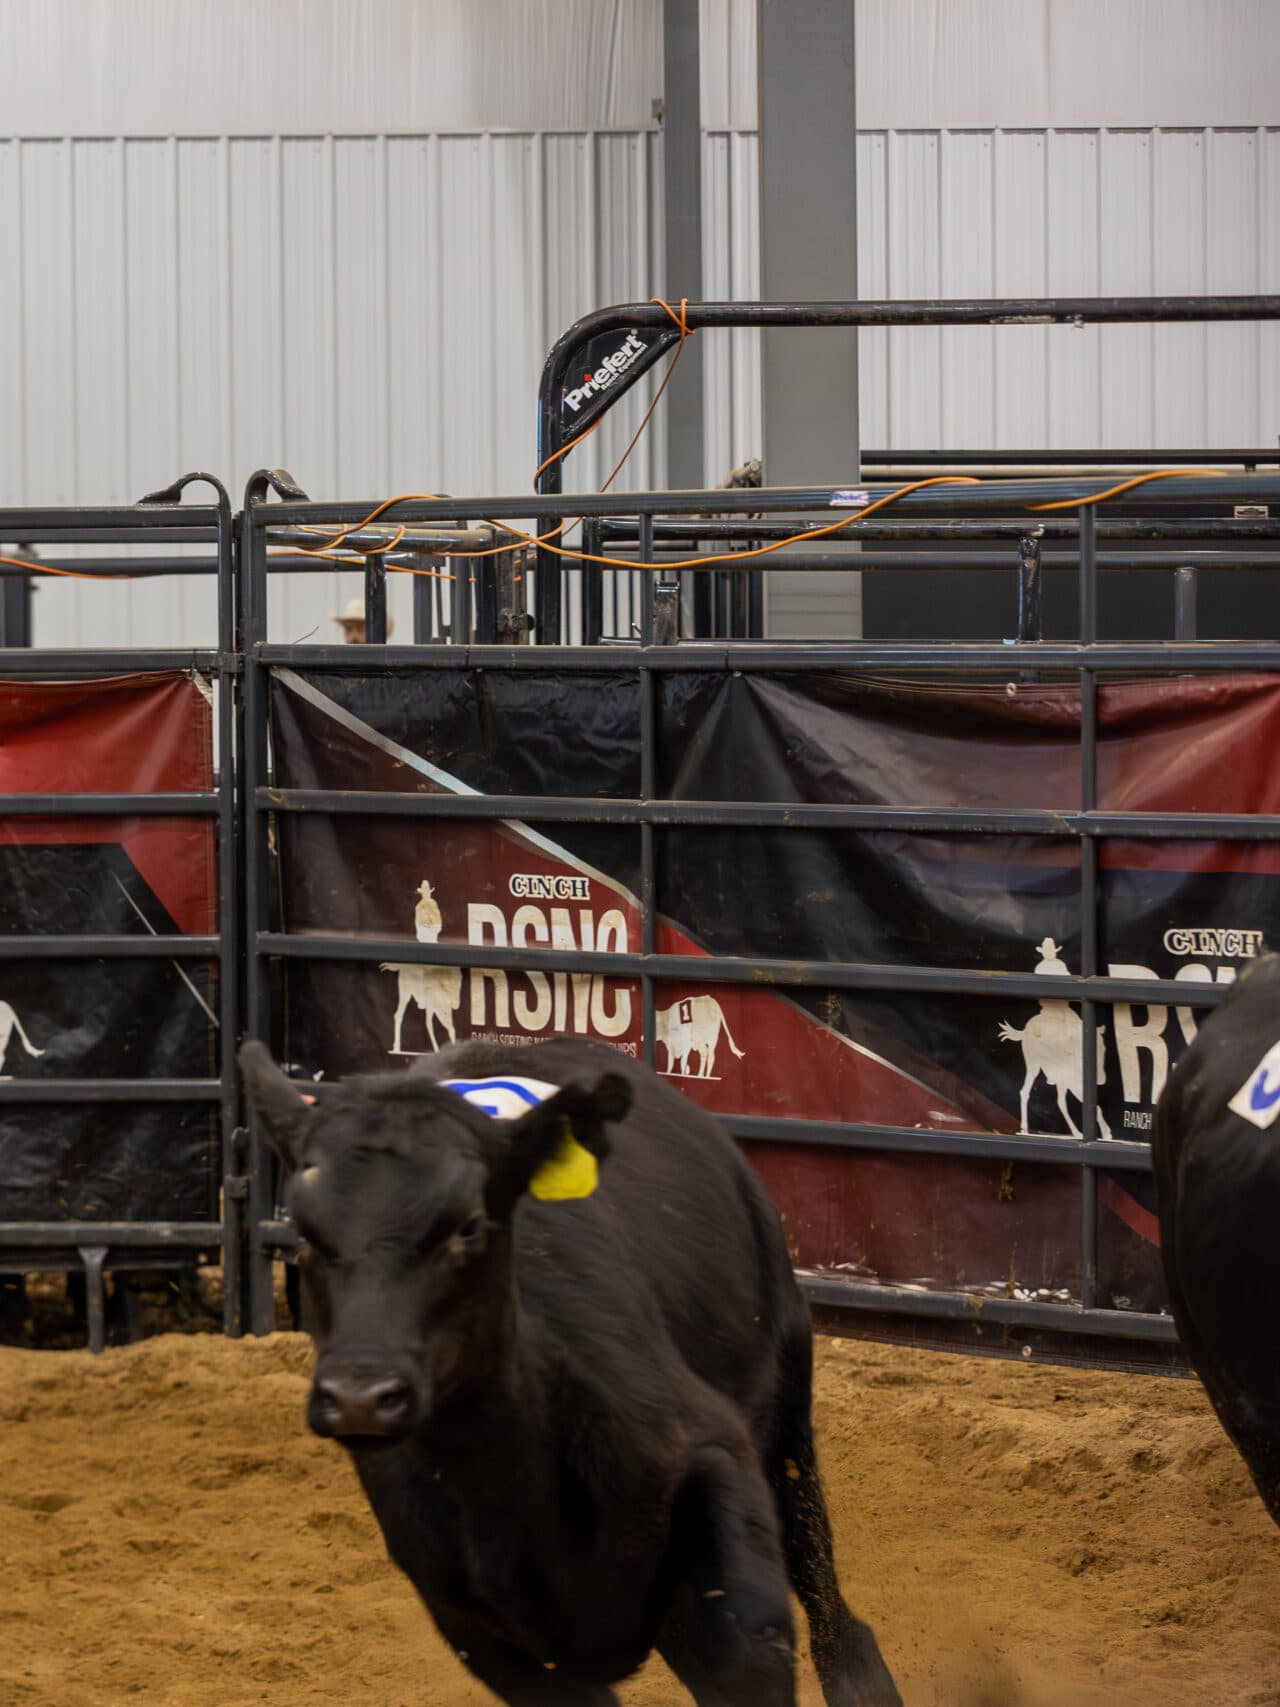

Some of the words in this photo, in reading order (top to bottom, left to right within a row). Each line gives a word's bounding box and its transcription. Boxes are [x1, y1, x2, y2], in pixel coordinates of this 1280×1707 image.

[564, 334, 642, 412] Priefert
[509, 873, 591, 901] CINCH
[1163, 928, 1264, 958] CINCH
[467, 902, 632, 1037] RSNC
[1123, 1110, 1153, 1130] RANCH
